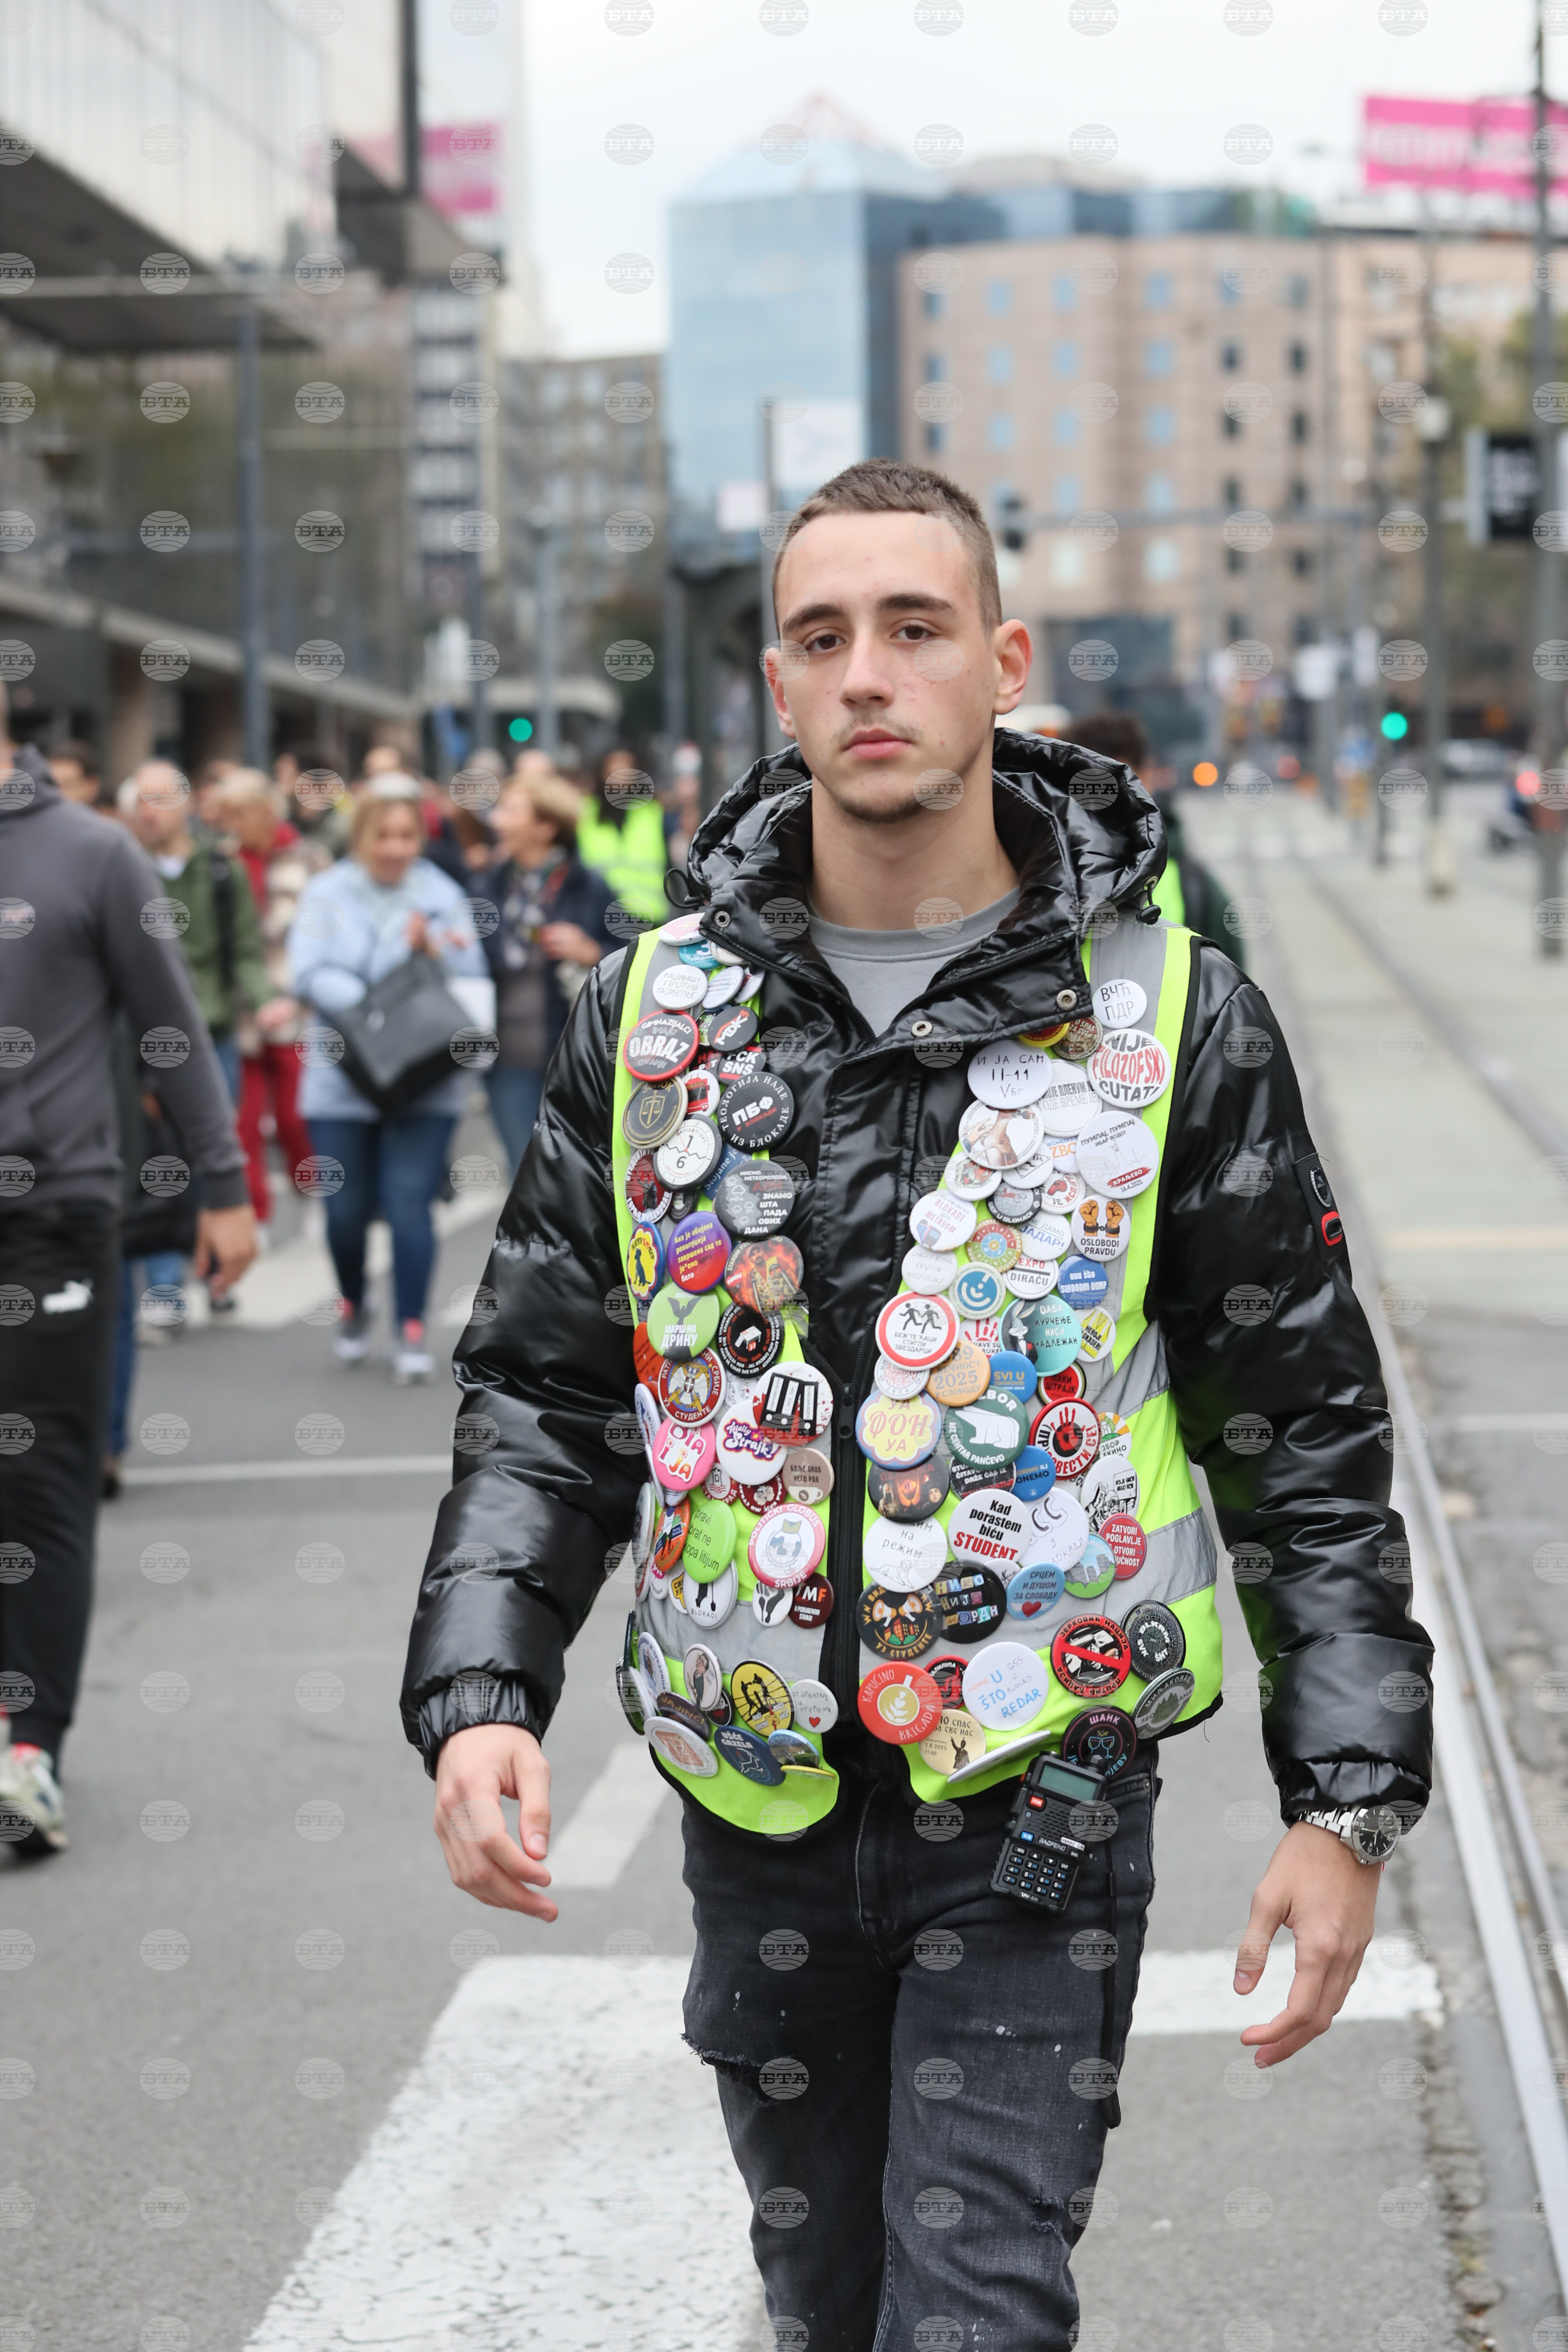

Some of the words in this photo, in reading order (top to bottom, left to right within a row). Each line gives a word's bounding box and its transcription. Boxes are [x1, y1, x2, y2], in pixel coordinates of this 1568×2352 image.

[1101, 983, 1131, 1001] ВЧЋ
[1105, 1001, 1134, 1021] ПДР
[642, 1019, 693, 1034] GIMNAZIJALCI
[629, 1035, 689, 1063] OBRAZ
[1105, 1033, 1155, 1052] NIJE
[995, 1055, 1009, 1064] ЈА
[1019, 1055, 1044, 1063] САМ
[1093, 1044, 1166, 1085] FILOZOFSKI
[722, 1062, 763, 1077] SNS
[1057, 1082, 1086, 1095] ПЛЕНУМ
[1099, 1077, 1160, 1102] ĆUTATI
[1042, 1097, 1060, 1112] ОДЕ
[1061, 1094, 1088, 1108] ВРЕМЕ
[732, 1096, 774, 1126] ПБФ
[1081, 1131, 1109, 1146] ПУМПАЈ,
[1109, 1118, 1135, 1133] ПУМПАЈ
[1095, 1137, 1109, 1146] ИБАР
[1110, 1130, 1127, 1140] ВОДО!
[1113, 1169, 1143, 1186] КРАЉЕВО
[934, 1199, 967, 1223] BLOKADE
[692, 1222, 713, 1235] обојена
[925, 1211, 957, 1234] METROOM
[676, 1236, 706, 1254] револуција
[1019, 1225, 1065, 1250] ЈАДАР!
[1081, 1238, 1119, 1247] OSLOBODI
[677, 1247, 703, 1263] завршена
[1084, 1246, 1115, 1256] PRAVDU
[1018, 1258, 1045, 1269] EXPO
[1011, 1273, 1049, 1286] DIRAĆU
[1040, 1304, 1063, 1315] ЏАБА
[1035, 1316, 1072, 1326] КУРЧЕЊЕ
[664, 1324, 685, 1334] МАРШ
[687, 1324, 696, 1334] НА
[1044, 1328, 1065, 1337] НИСИ
[1085, 1325, 1102, 1341] HEROJI
[660, 1334, 698, 1349] ДРИНУ
[894, 1344, 932, 1354] ЗВЕЗДАРЦИ
[1035, 1337, 1078, 1348] НАДЛЕЖАН
[934, 1370, 978, 1390] 2025
[994, 1372, 1013, 1380] SVI
[942, 1385, 980, 1397] СЛОБОДУ
[1045, 1383, 1076, 1393] ШТРАЈК
[664, 1397, 671, 1408] УЗ
[675, 1405, 711, 1421] СТУДЕНТЕ
[726, 1421, 752, 1435] Totally
[870, 1411, 928, 1439] ФОН
[949, 1422, 956, 1434] MZ
[725, 1432, 780, 1459] Strajk!
[885, 1439, 906, 1452] УА
[950, 1435, 970, 1459] CENTAR
[1102, 1440, 1119, 1451] ЗБОР
[970, 1453, 1005, 1465] PANČEVO
[989, 1500, 1012, 1516] Kad
[694, 1509, 713, 1525] pravi
[787, 1505, 820, 1527] GLOBUS
[969, 1508, 1022, 1533] porastem
[689, 1524, 703, 1540] brat
[703, 1535, 711, 1546] ne
[901, 1530, 914, 1541] на
[979, 1524, 1004, 1541] biću
[1112, 1524, 1137, 1535] ZATVORI
[954, 1531, 1018, 1560] STUDENT
[1106, 1533, 1141, 1546] POGLAVLJE
[882, 1538, 922, 1559] режим
[1114, 1546, 1136, 1556] OTVORI
[774, 1570, 807, 1588] SRBIJE
[1029, 1582, 1057, 1590] ДУШОМ
[1025, 1592, 1058, 1600] СЛОБОДУ
[691, 1608, 717, 1619] BLOKADI
[1060, 1615, 1100, 1638] ЈЕРКОВИЋ
[1104, 1620, 1129, 1651] НАЦИЈА
[876, 1642, 886, 1653] УЗ
[890, 1633, 933, 1658] СТУДЕНТЕ
[1006, 1655, 1024, 1671] GSS
[1145, 1677, 1191, 1708] МИЉАКОВАЦ
[1000, 1688, 1043, 1719] REDAR
[899, 1704, 936, 1740] BRIGADA
[952, 1719, 972, 1729] СПАС
[1089, 1714, 1121, 1725] ШАНК
[721, 1731, 744, 1741] UŠĆE
[960, 1728, 974, 1736] НАС
[721, 1739, 753, 1749] GAZELA
[1038, 1838, 1067, 1851] BAOFENG
